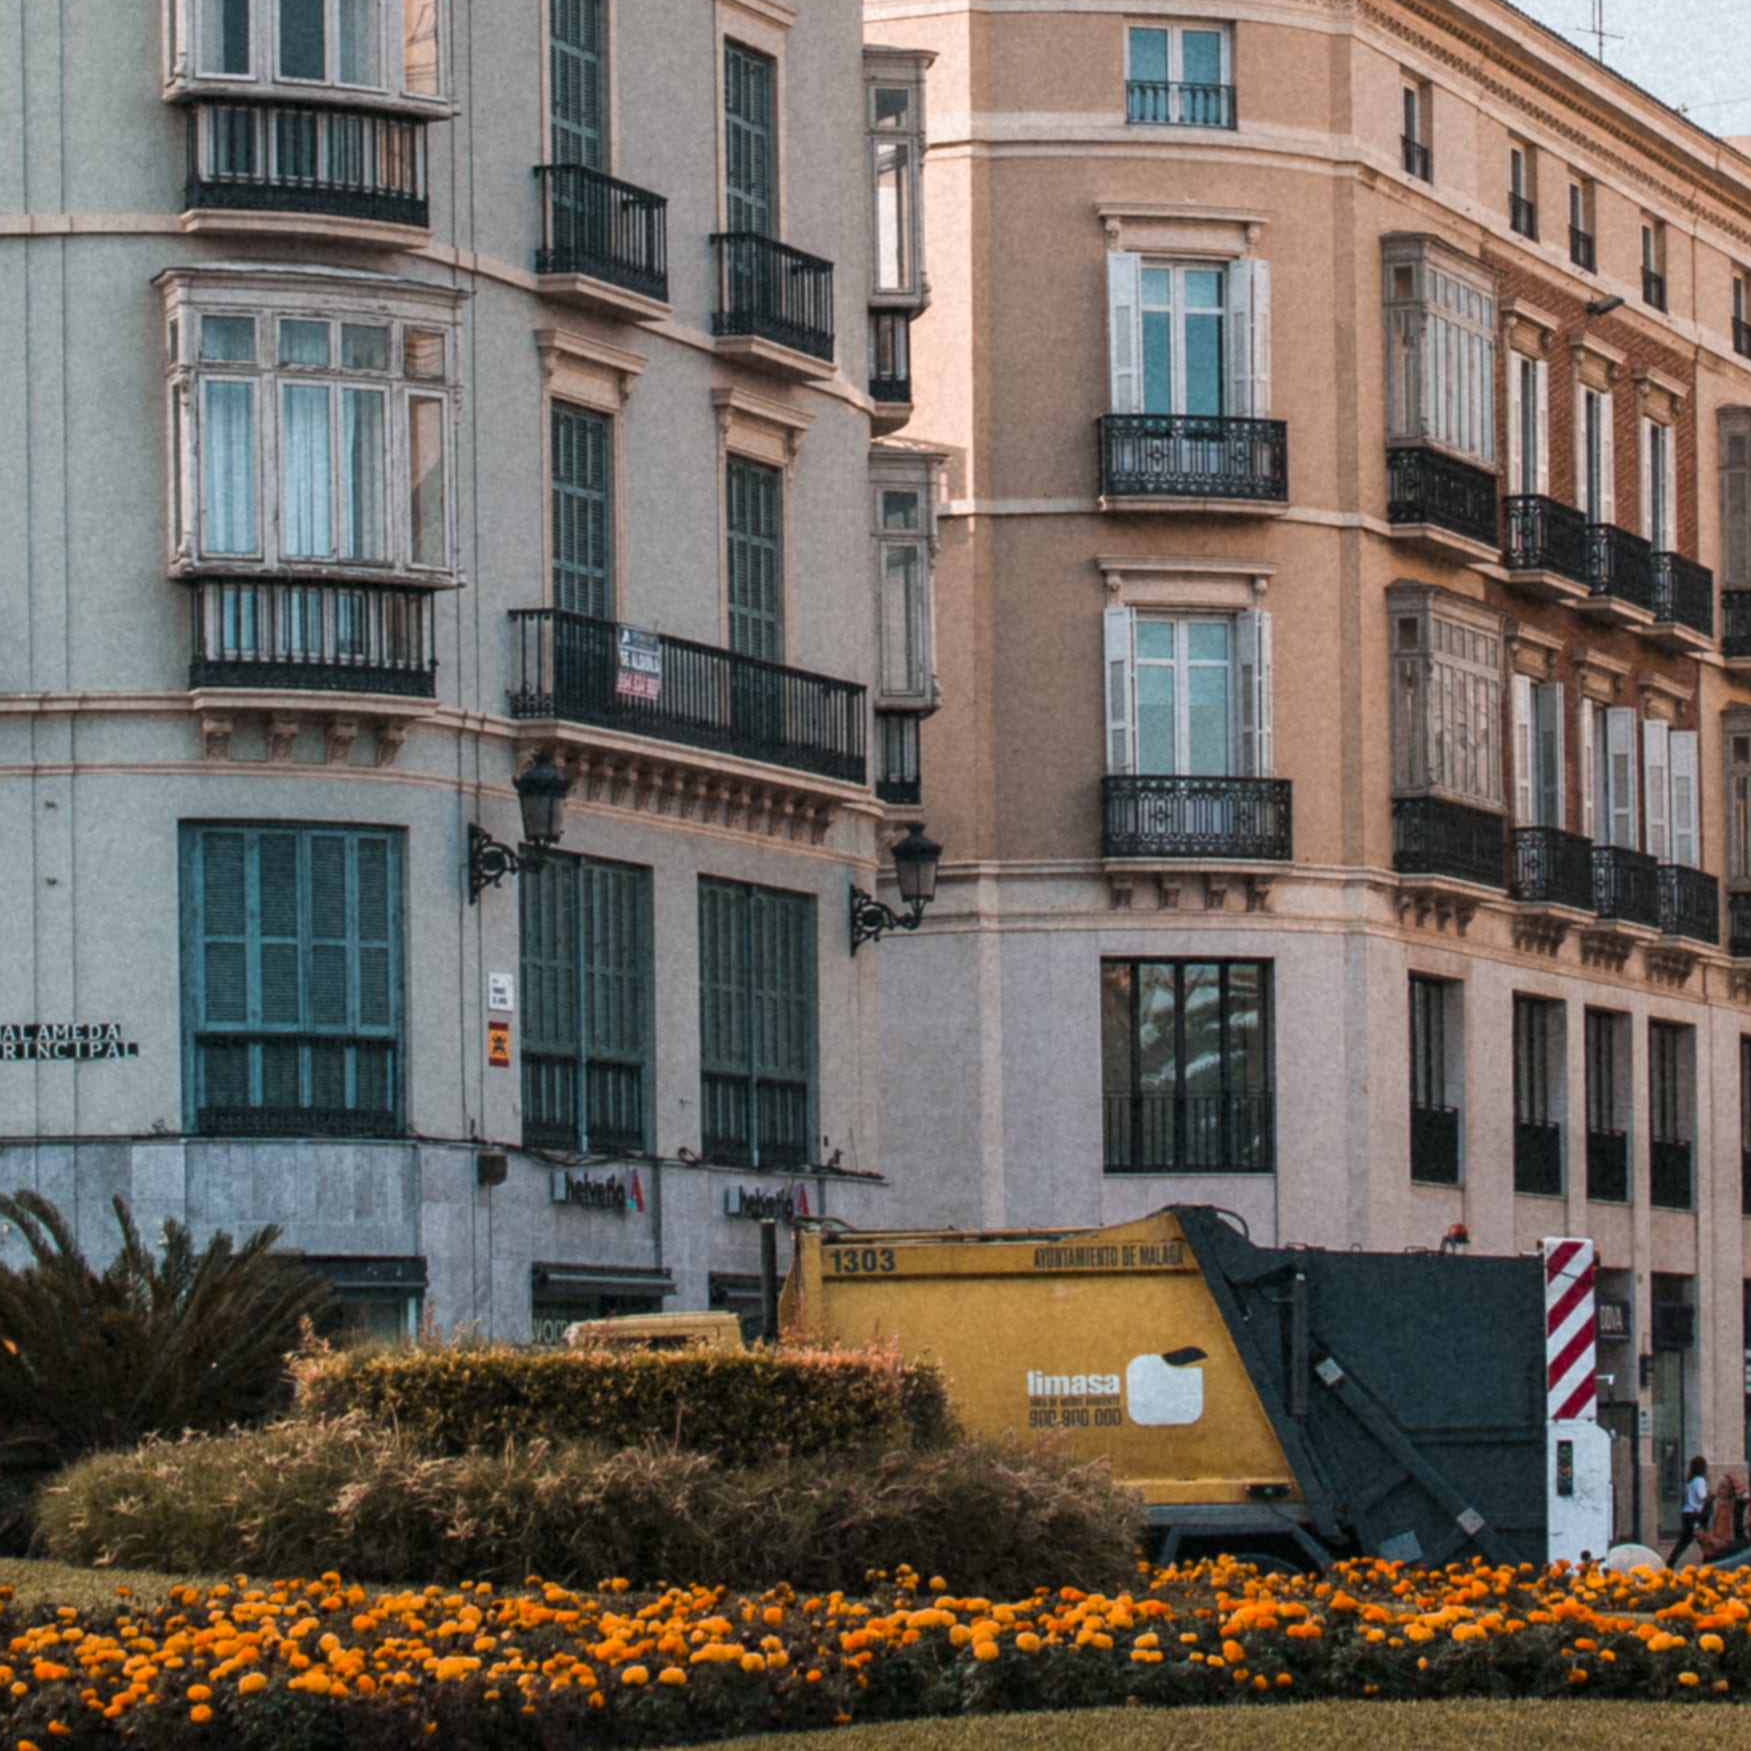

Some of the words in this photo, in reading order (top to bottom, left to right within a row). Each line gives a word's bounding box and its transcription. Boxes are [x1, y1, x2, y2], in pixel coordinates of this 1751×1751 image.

[2, 1023, 121, 1041] ALAMEDA
[830, 1249, 896, 1273] 1303
[1122, 1245, 1136, 1266] DE
[1027, 1370, 1121, 1397] limasa
[1029, 1409, 1057, 1428] 900
[1061, 1408, 1090, 1427] 900
[1095, 1407, 1123, 1426] 000
